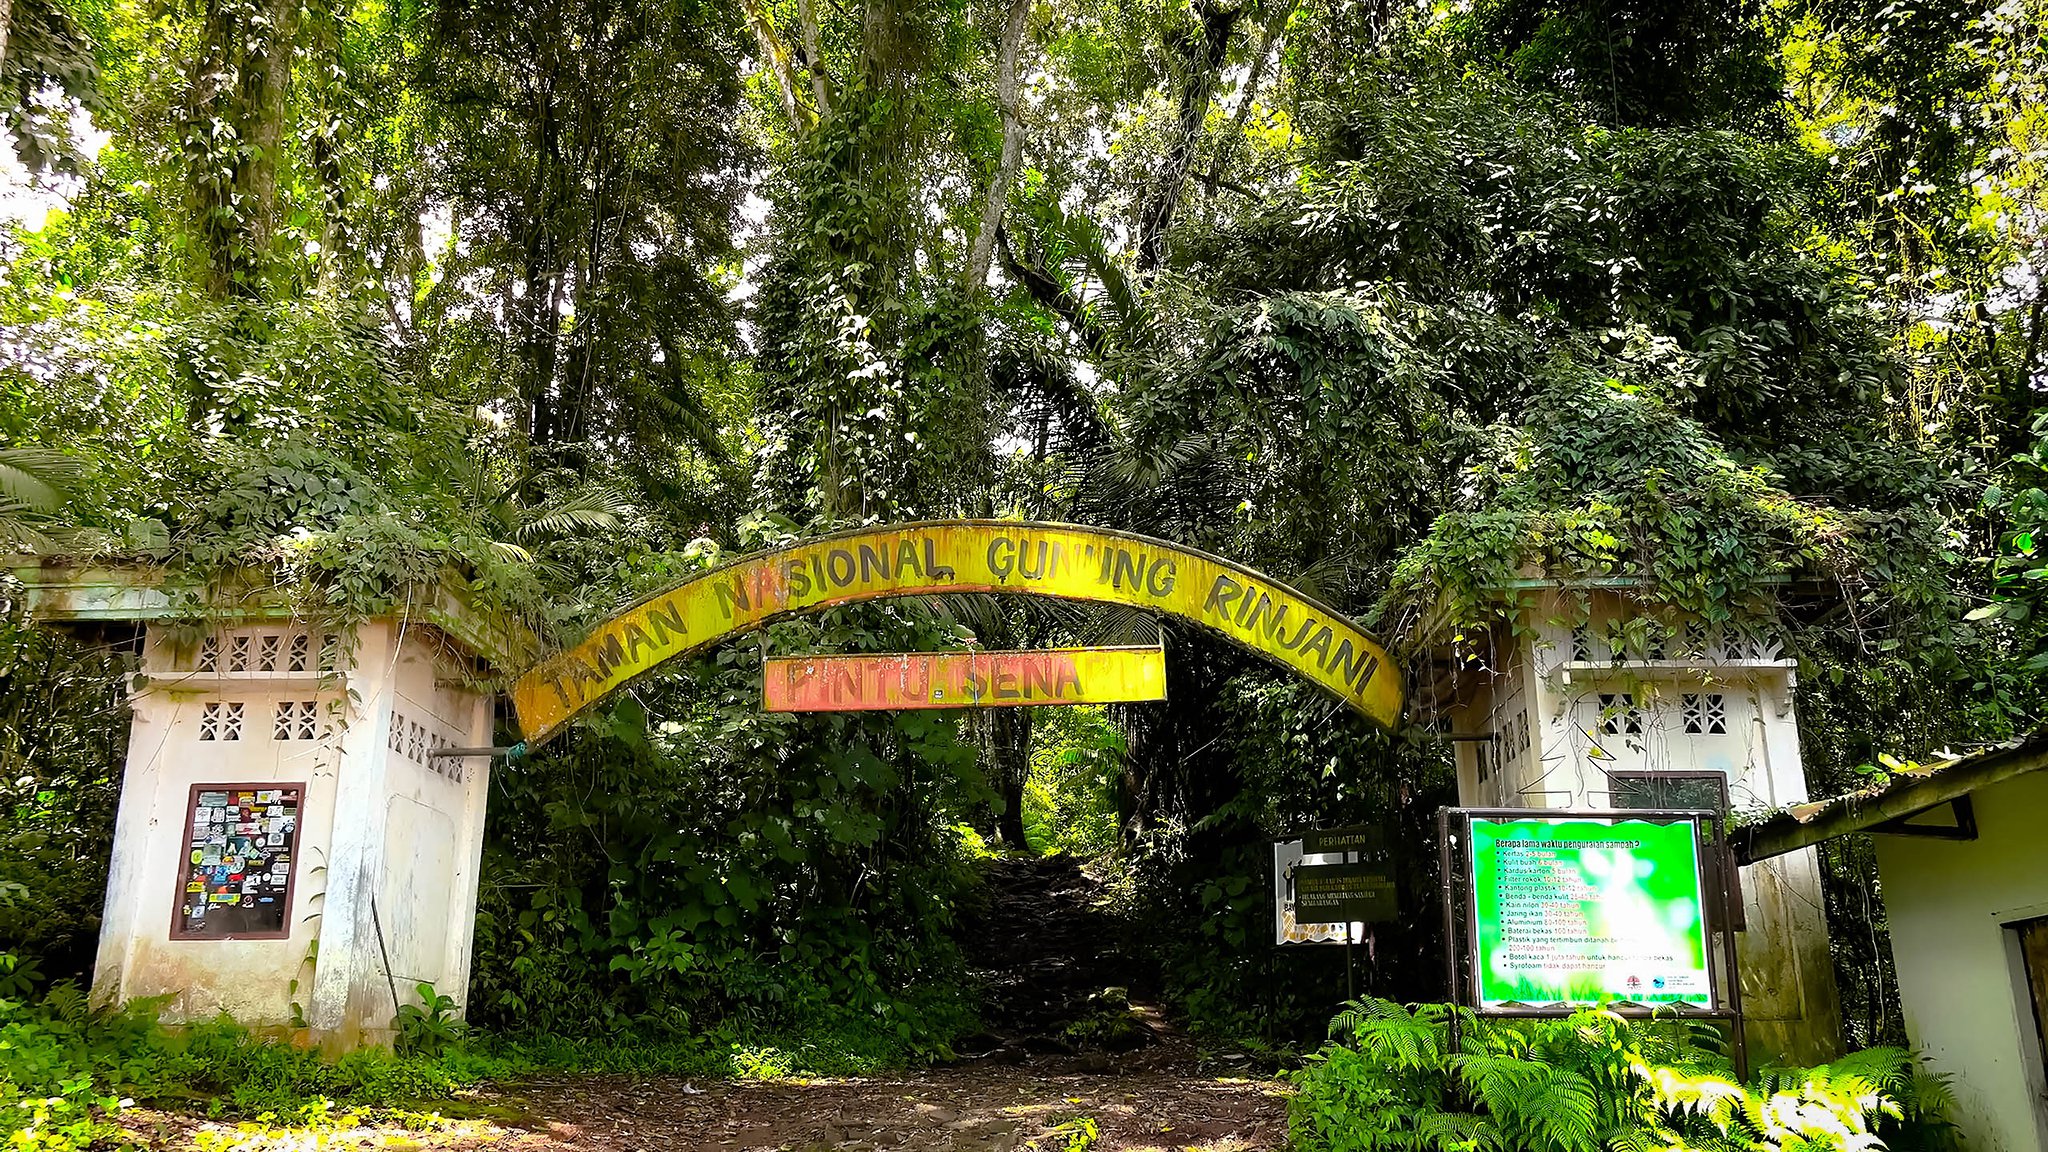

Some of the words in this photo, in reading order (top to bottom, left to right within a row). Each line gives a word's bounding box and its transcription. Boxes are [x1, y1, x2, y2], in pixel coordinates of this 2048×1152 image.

[1203, 574, 1379, 696] RINJANI
[785, 657, 929, 703] PINTU
[1496, 839, 1521, 849] Berapa
[1522, 839, 1540, 849] lama
[1541, 839, 1563, 849] waktu
[1564, 839, 1605, 849] penguraian
